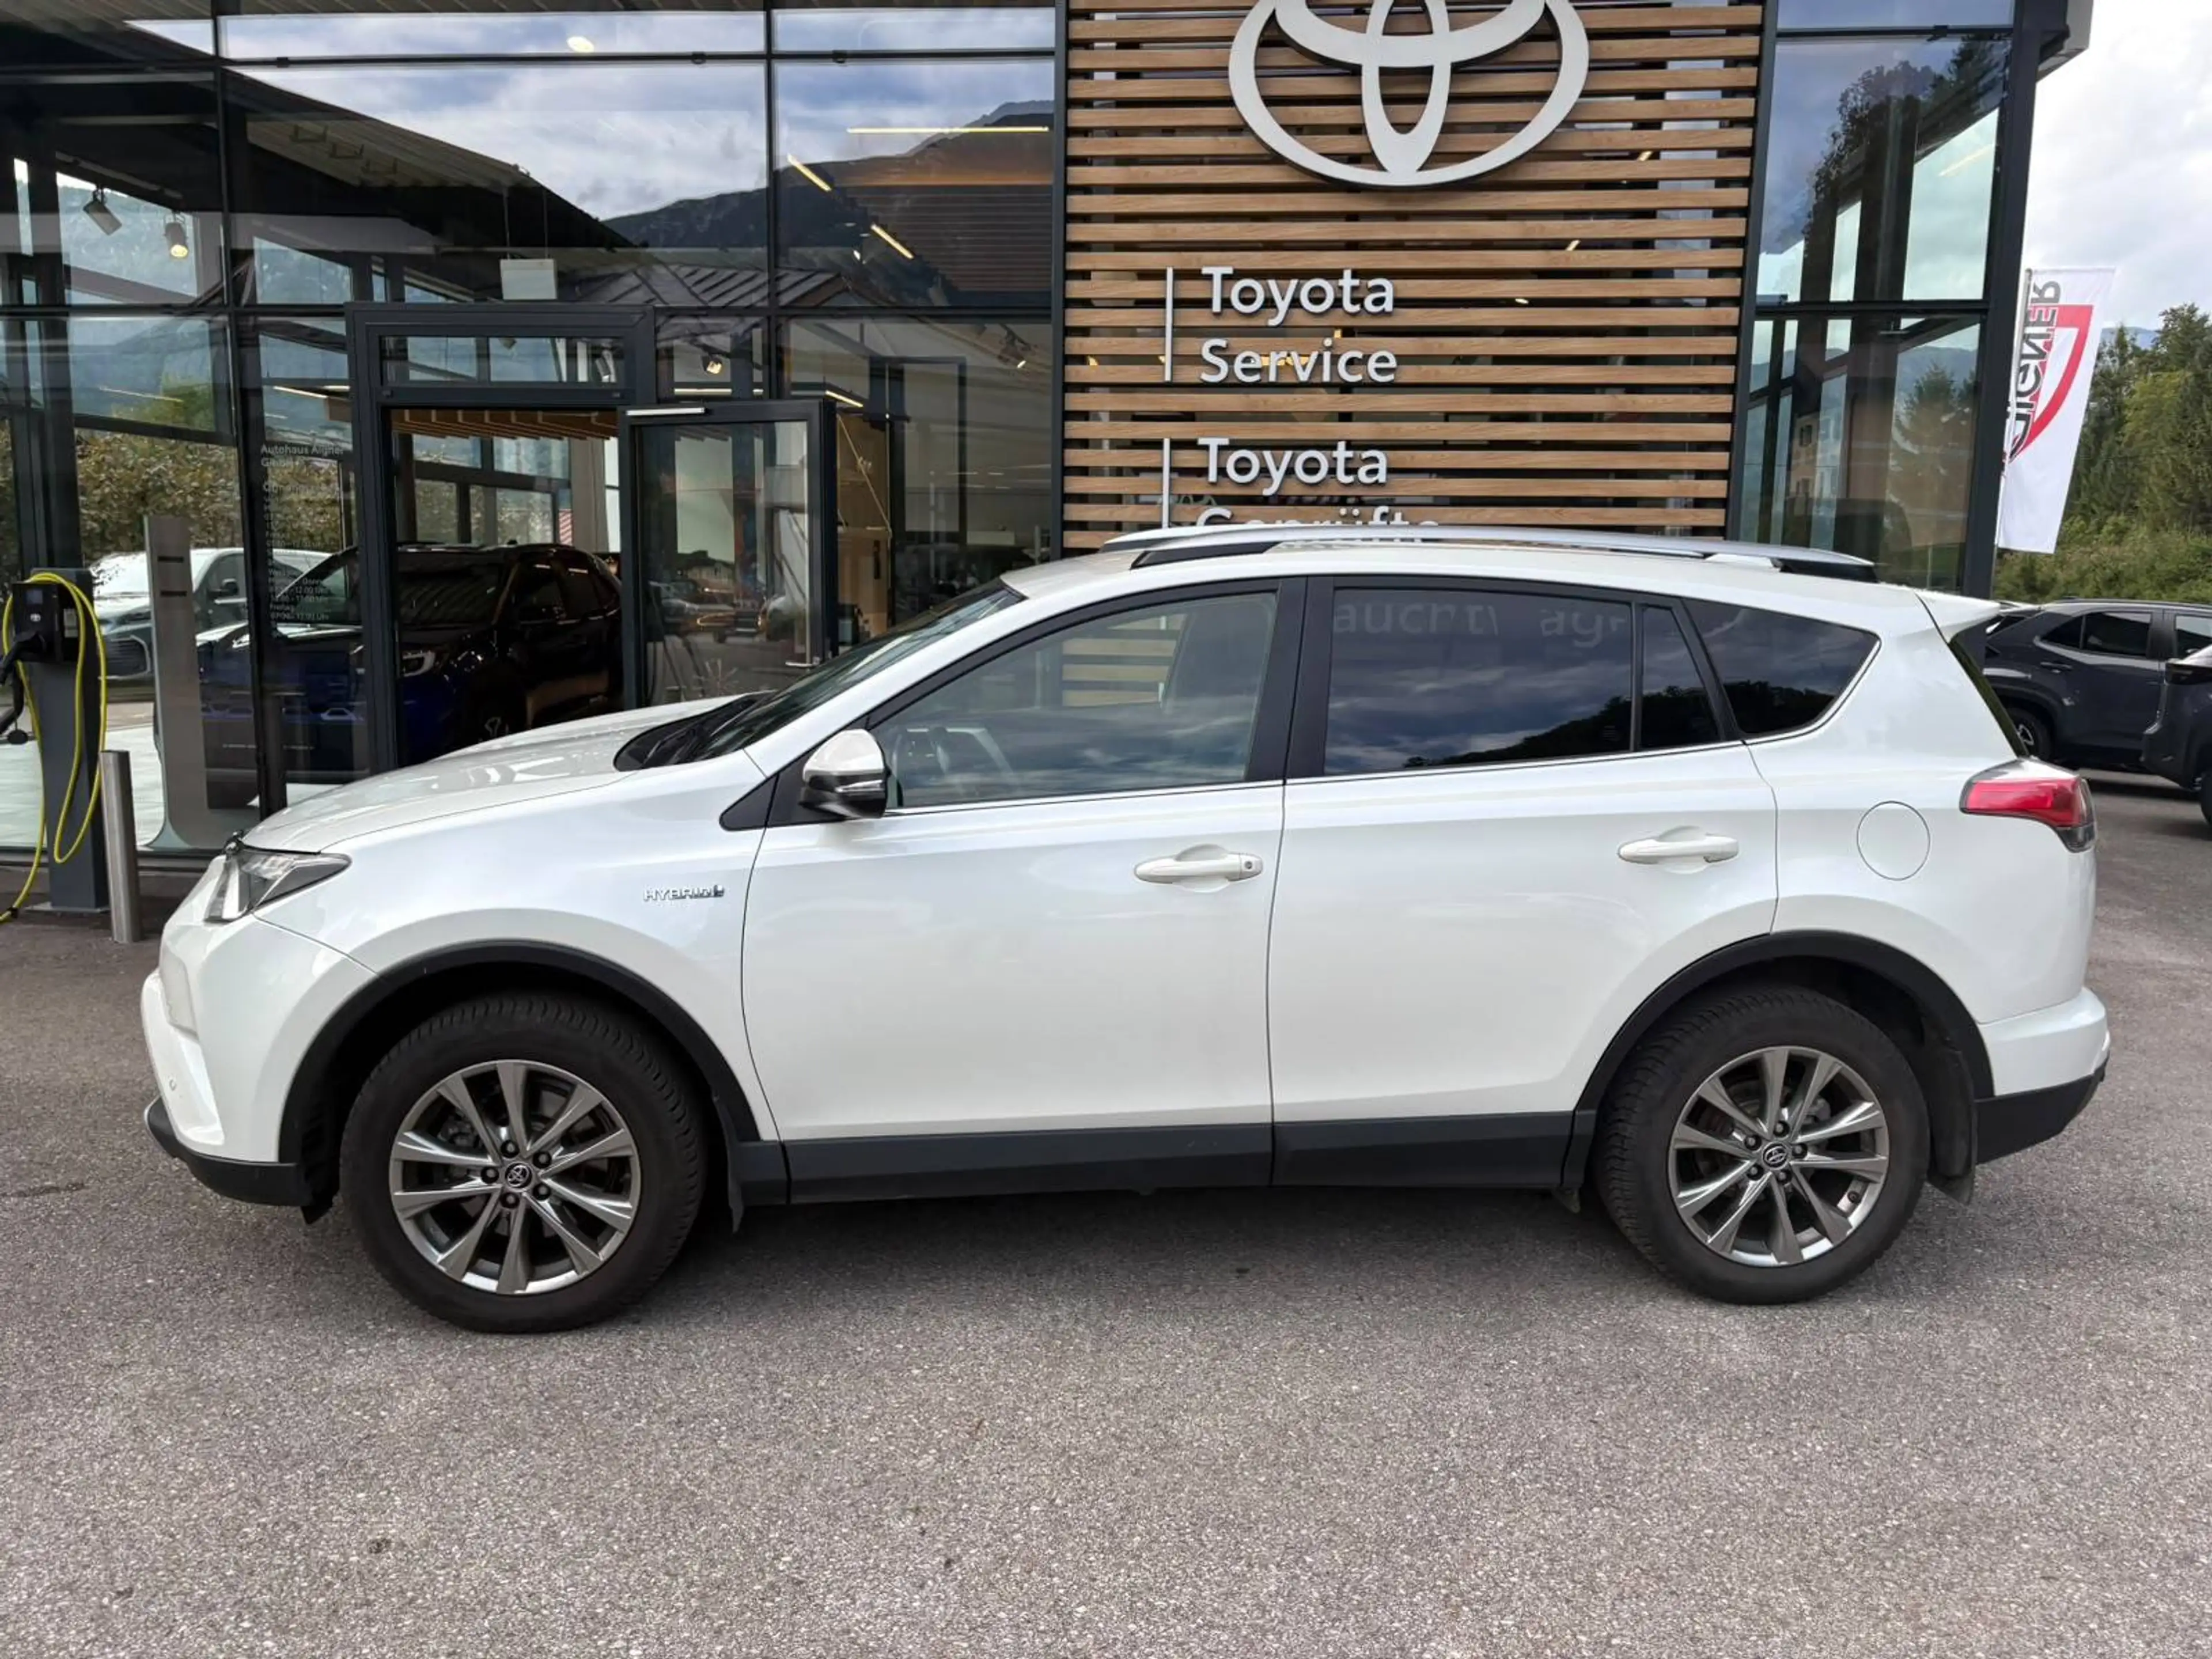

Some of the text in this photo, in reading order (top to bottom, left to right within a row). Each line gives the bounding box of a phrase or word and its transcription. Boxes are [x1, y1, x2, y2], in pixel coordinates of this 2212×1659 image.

[1201, 266, 1394, 327] Toyota
[1200, 338, 1397, 383] Service
[260, 444, 309, 455] Autohaus
[1197, 437, 1388, 497] Toyota
[643, 886, 711, 902] HYBRID
